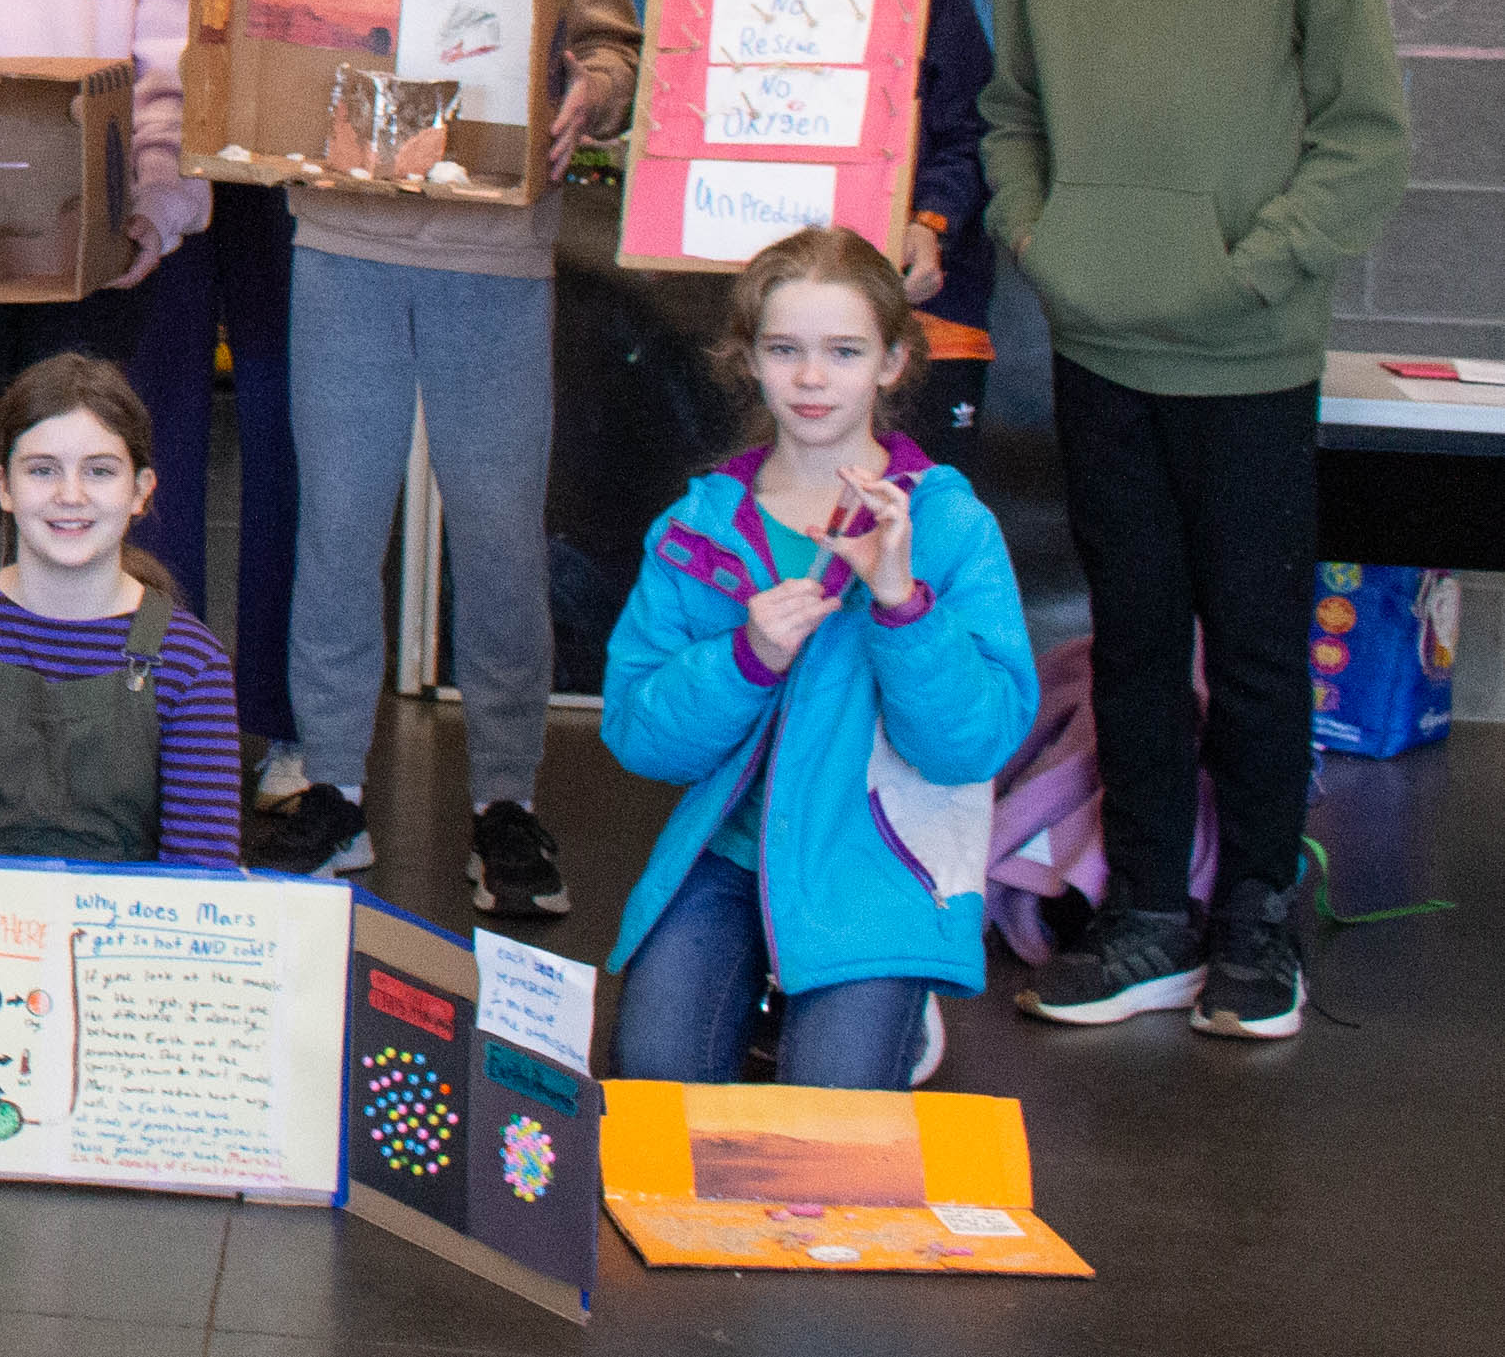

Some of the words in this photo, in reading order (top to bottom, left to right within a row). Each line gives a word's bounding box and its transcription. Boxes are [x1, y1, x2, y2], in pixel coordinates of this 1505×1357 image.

[127, 900, 179, 923] does
[196, 901, 257, 928] Mars
[153, 935, 183, 951] hot
[190, 939, 227, 956] AND
